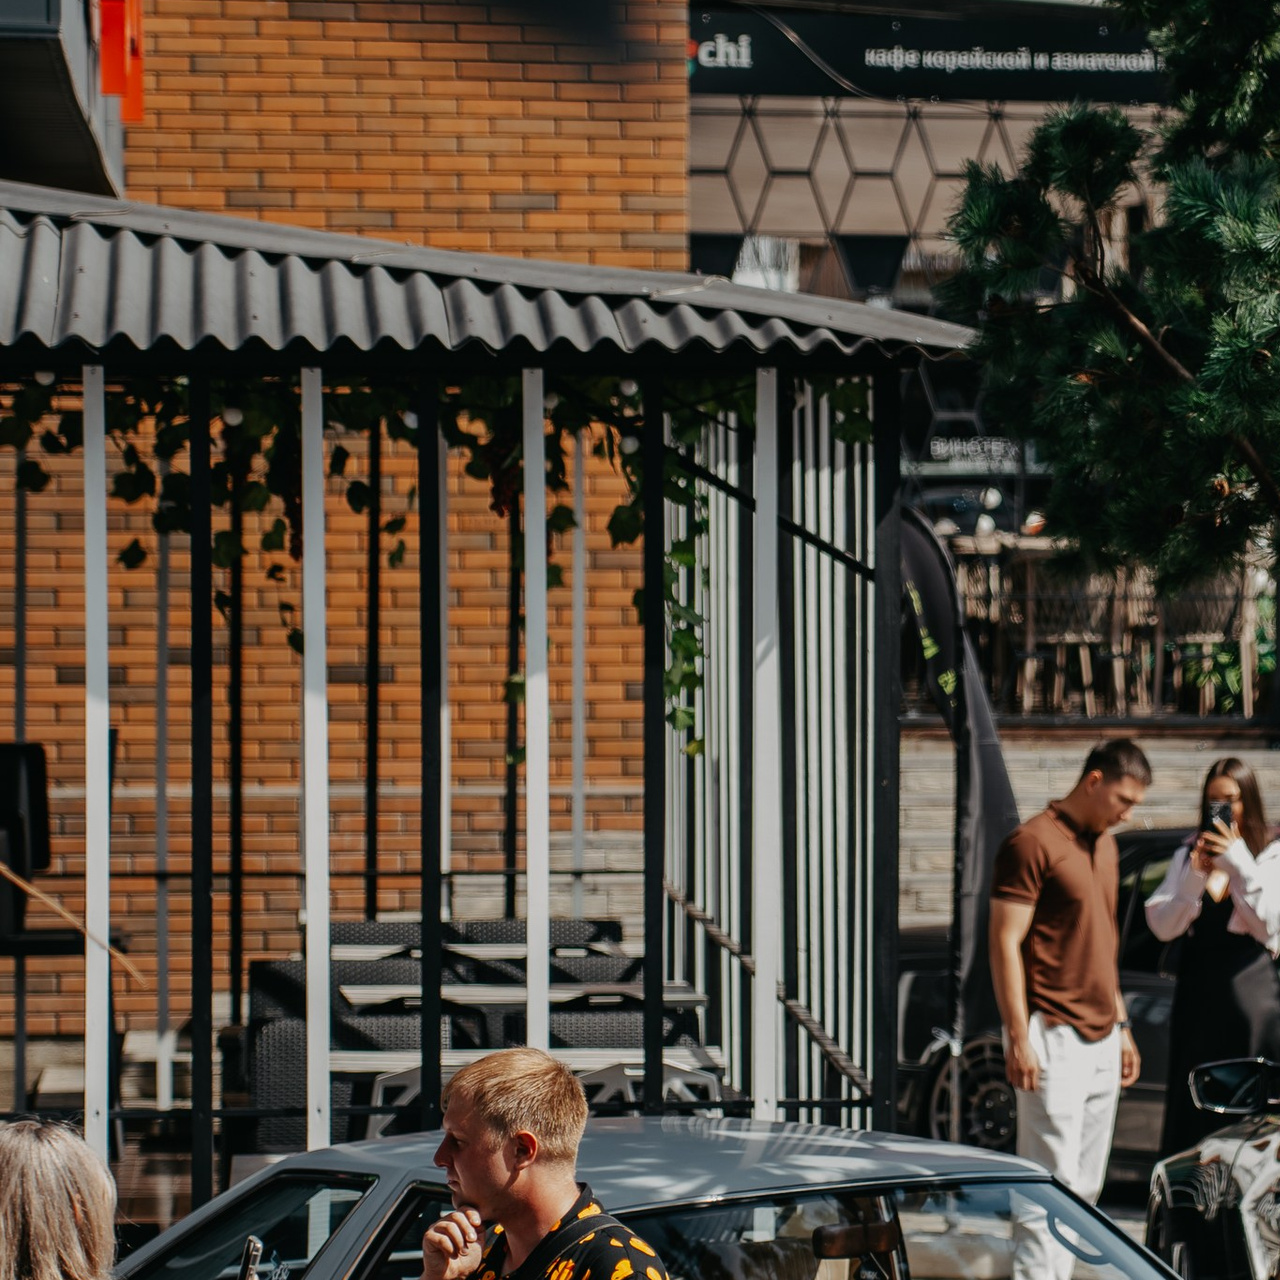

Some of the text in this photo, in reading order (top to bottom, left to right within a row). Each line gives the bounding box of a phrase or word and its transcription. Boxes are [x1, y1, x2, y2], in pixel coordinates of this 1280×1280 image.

[865, 45, 920, 71] кафе
[922, 46, 1031, 74] корейской
[1034, 52, 1049, 70] и
[1051, 48, 1155, 72] азиатской
